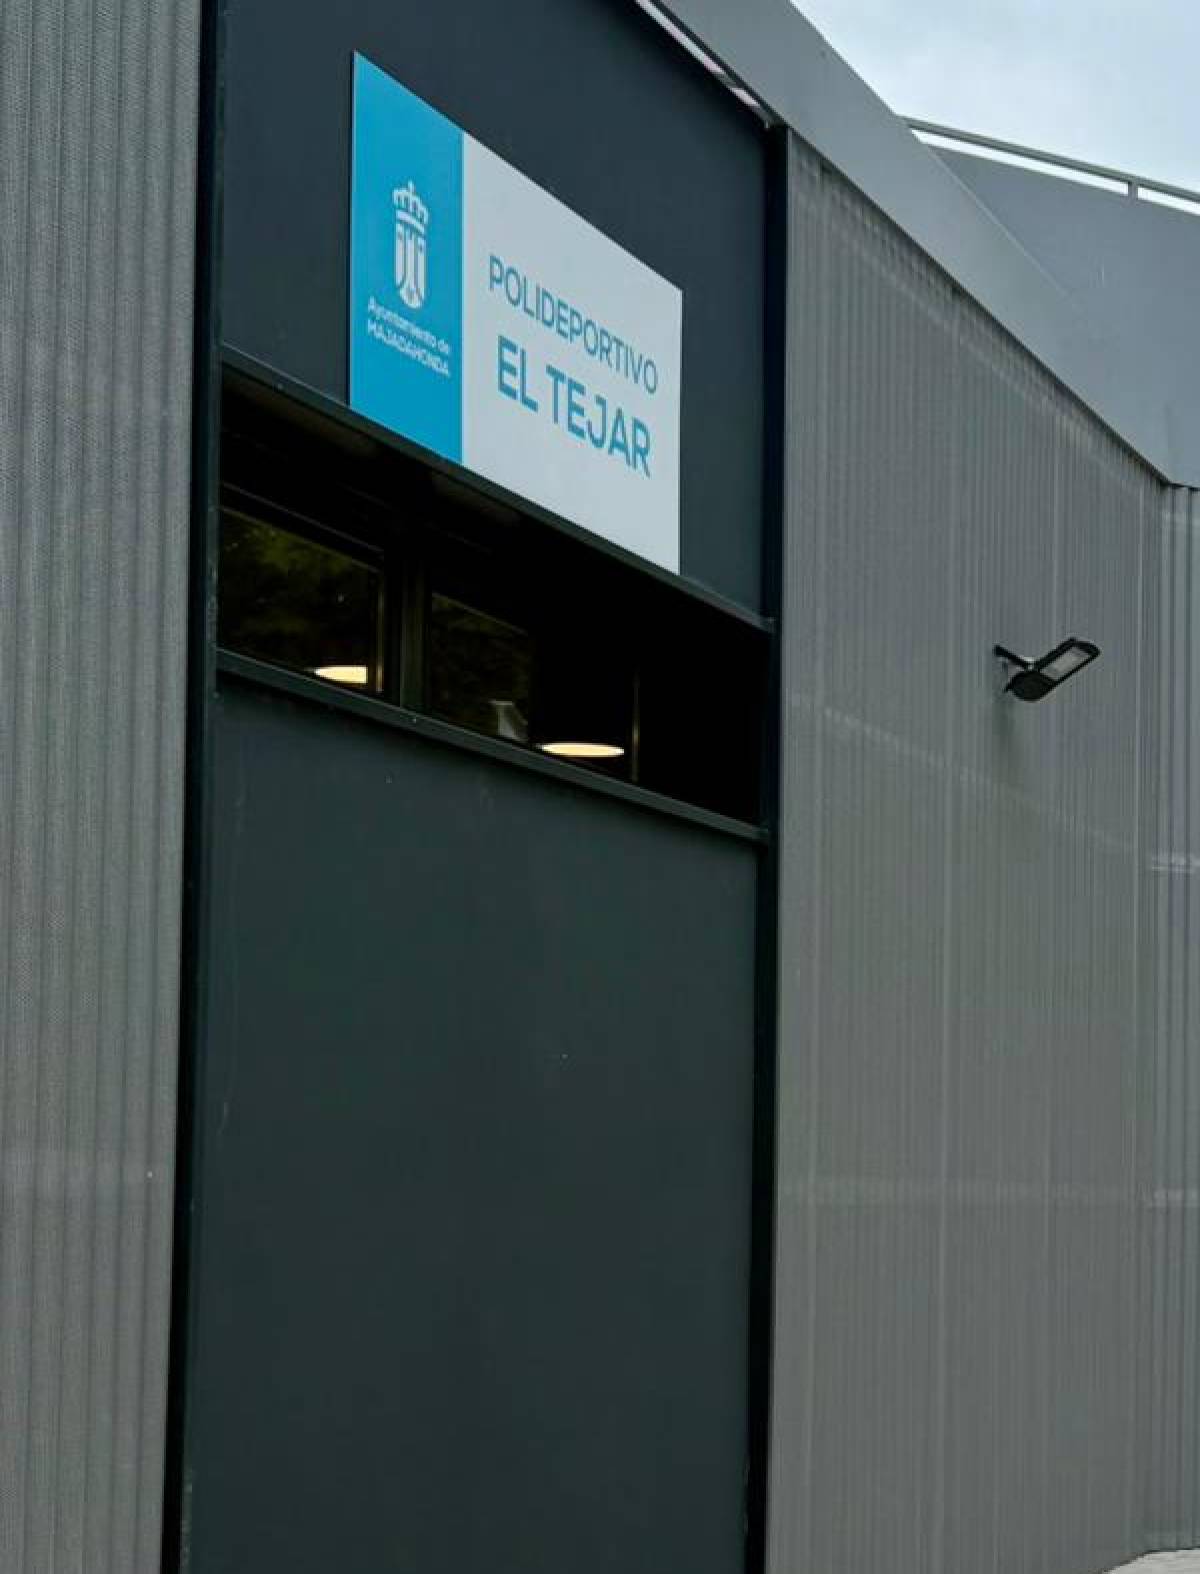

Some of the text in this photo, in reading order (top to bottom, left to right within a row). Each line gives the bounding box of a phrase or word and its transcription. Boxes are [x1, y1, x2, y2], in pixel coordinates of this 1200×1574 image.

[489, 254, 658, 394] POLIDEPORTIVO
[498, 335, 651, 477] EL TEJAR
